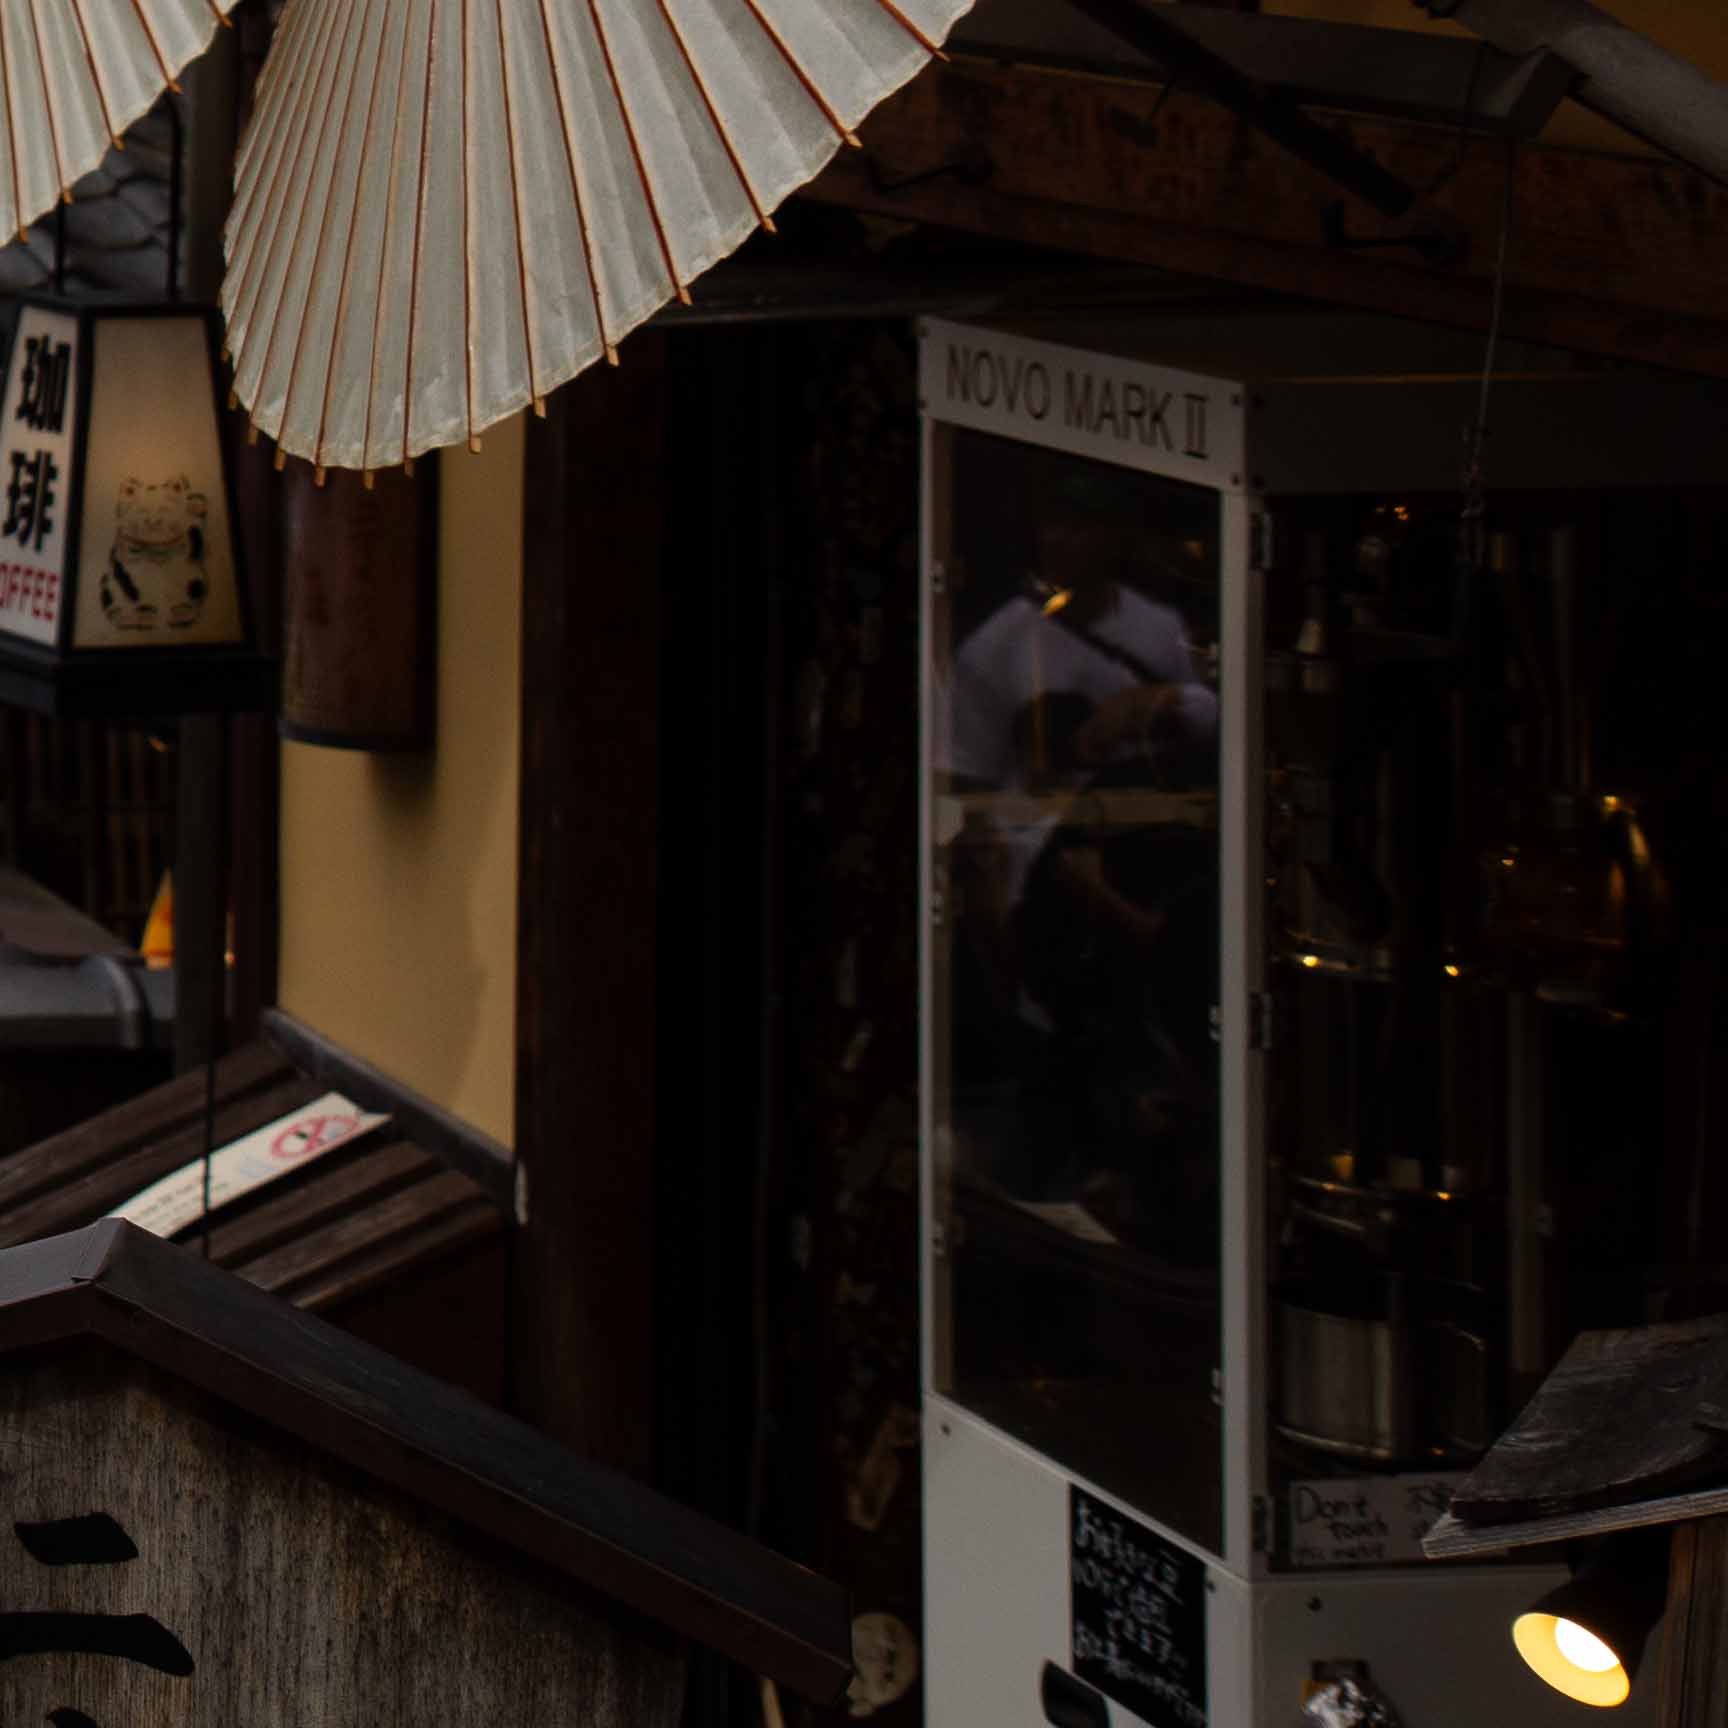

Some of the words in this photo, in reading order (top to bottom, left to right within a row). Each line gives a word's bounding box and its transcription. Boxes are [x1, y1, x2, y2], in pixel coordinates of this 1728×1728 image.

[3, 335, 70, 551] 珈琲
[947, 345, 1049, 419] NOVO
[1062, 370, 1174, 452] MARK
